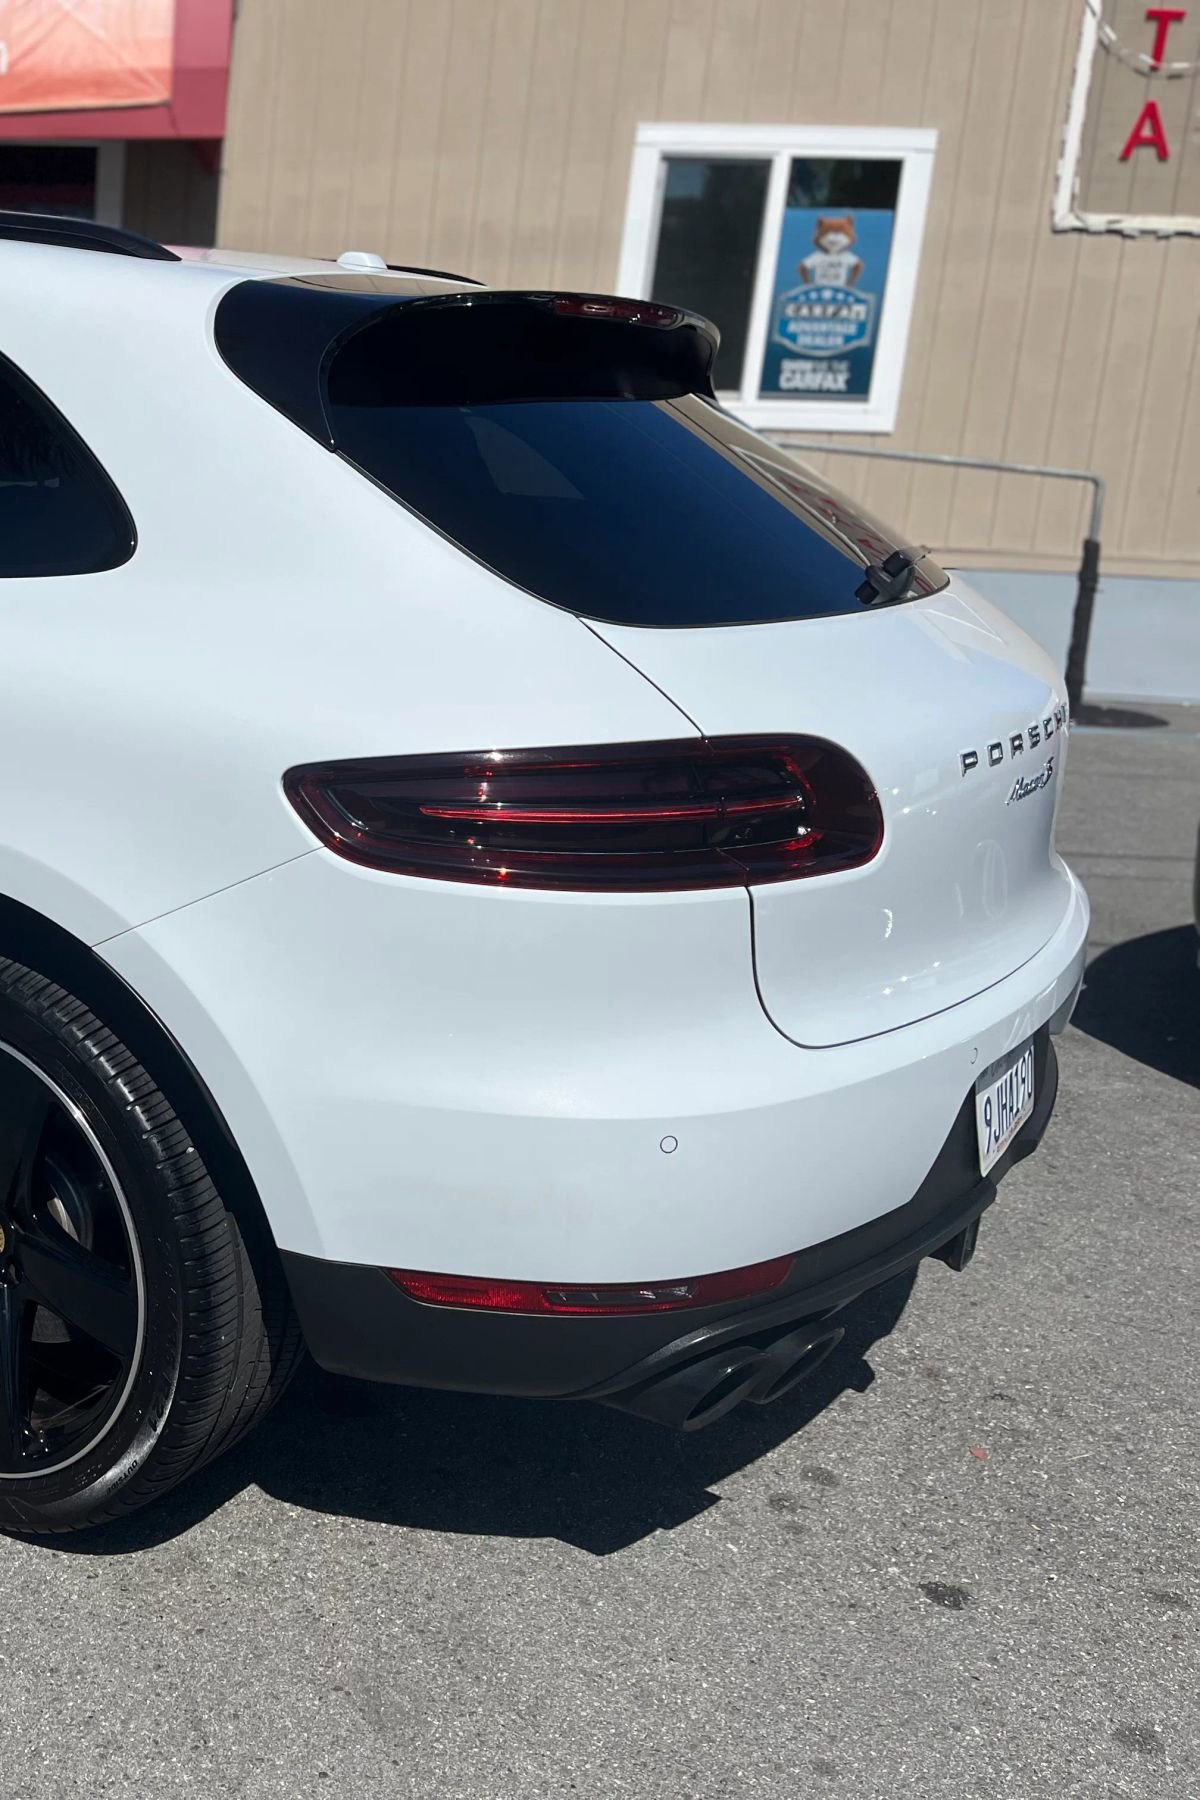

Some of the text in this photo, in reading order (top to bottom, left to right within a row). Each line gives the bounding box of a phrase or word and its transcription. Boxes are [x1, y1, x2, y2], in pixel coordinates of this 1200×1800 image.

[1119, 99, 1171, 162] A
[785, 303, 868, 320] CARFAX
[779, 370, 850, 392] CARFAX
